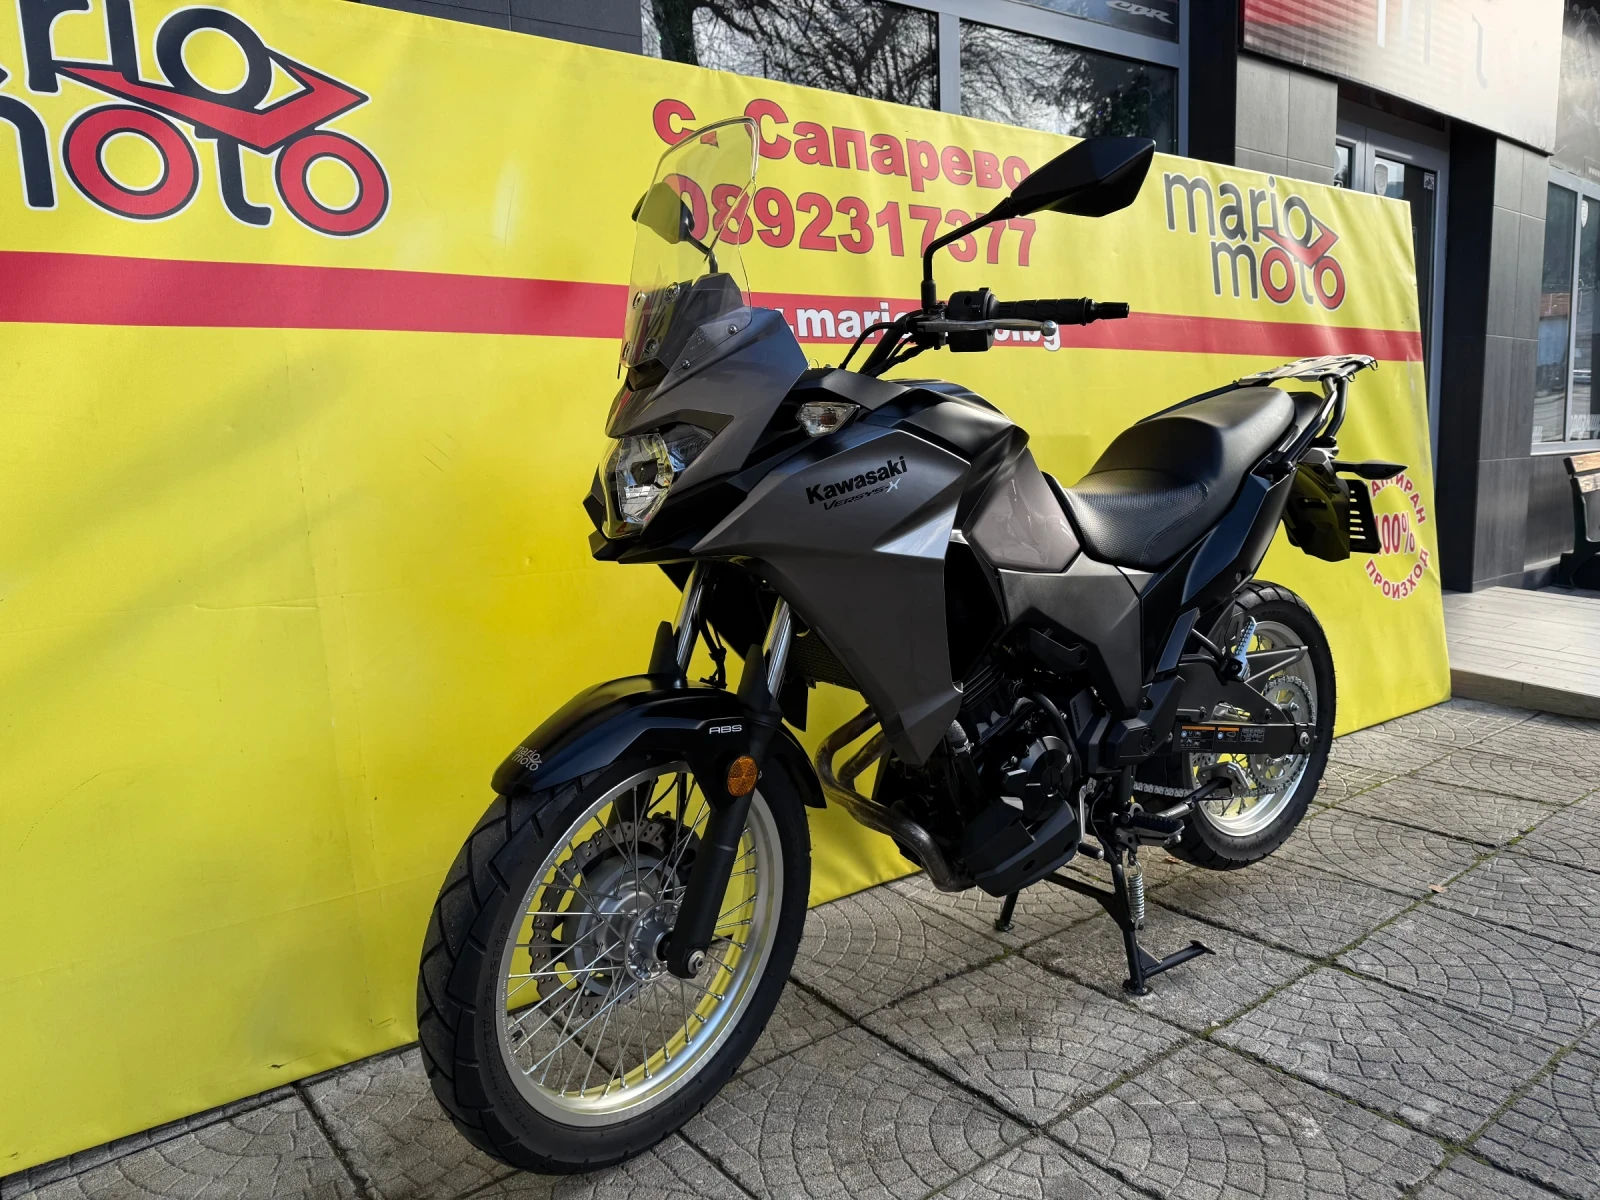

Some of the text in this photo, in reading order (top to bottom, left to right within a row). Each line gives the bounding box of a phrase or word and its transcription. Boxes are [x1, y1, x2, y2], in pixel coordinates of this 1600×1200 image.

[1105, 0, 1175, 24] CBR
[743, 98, 1031, 193] Сапарево
[1164, 172, 1313, 249] mario
[1210, 240, 1346, 310] moto
[805, 455, 908, 505] Kawasaki
[709, 724, 742, 735] ABS
